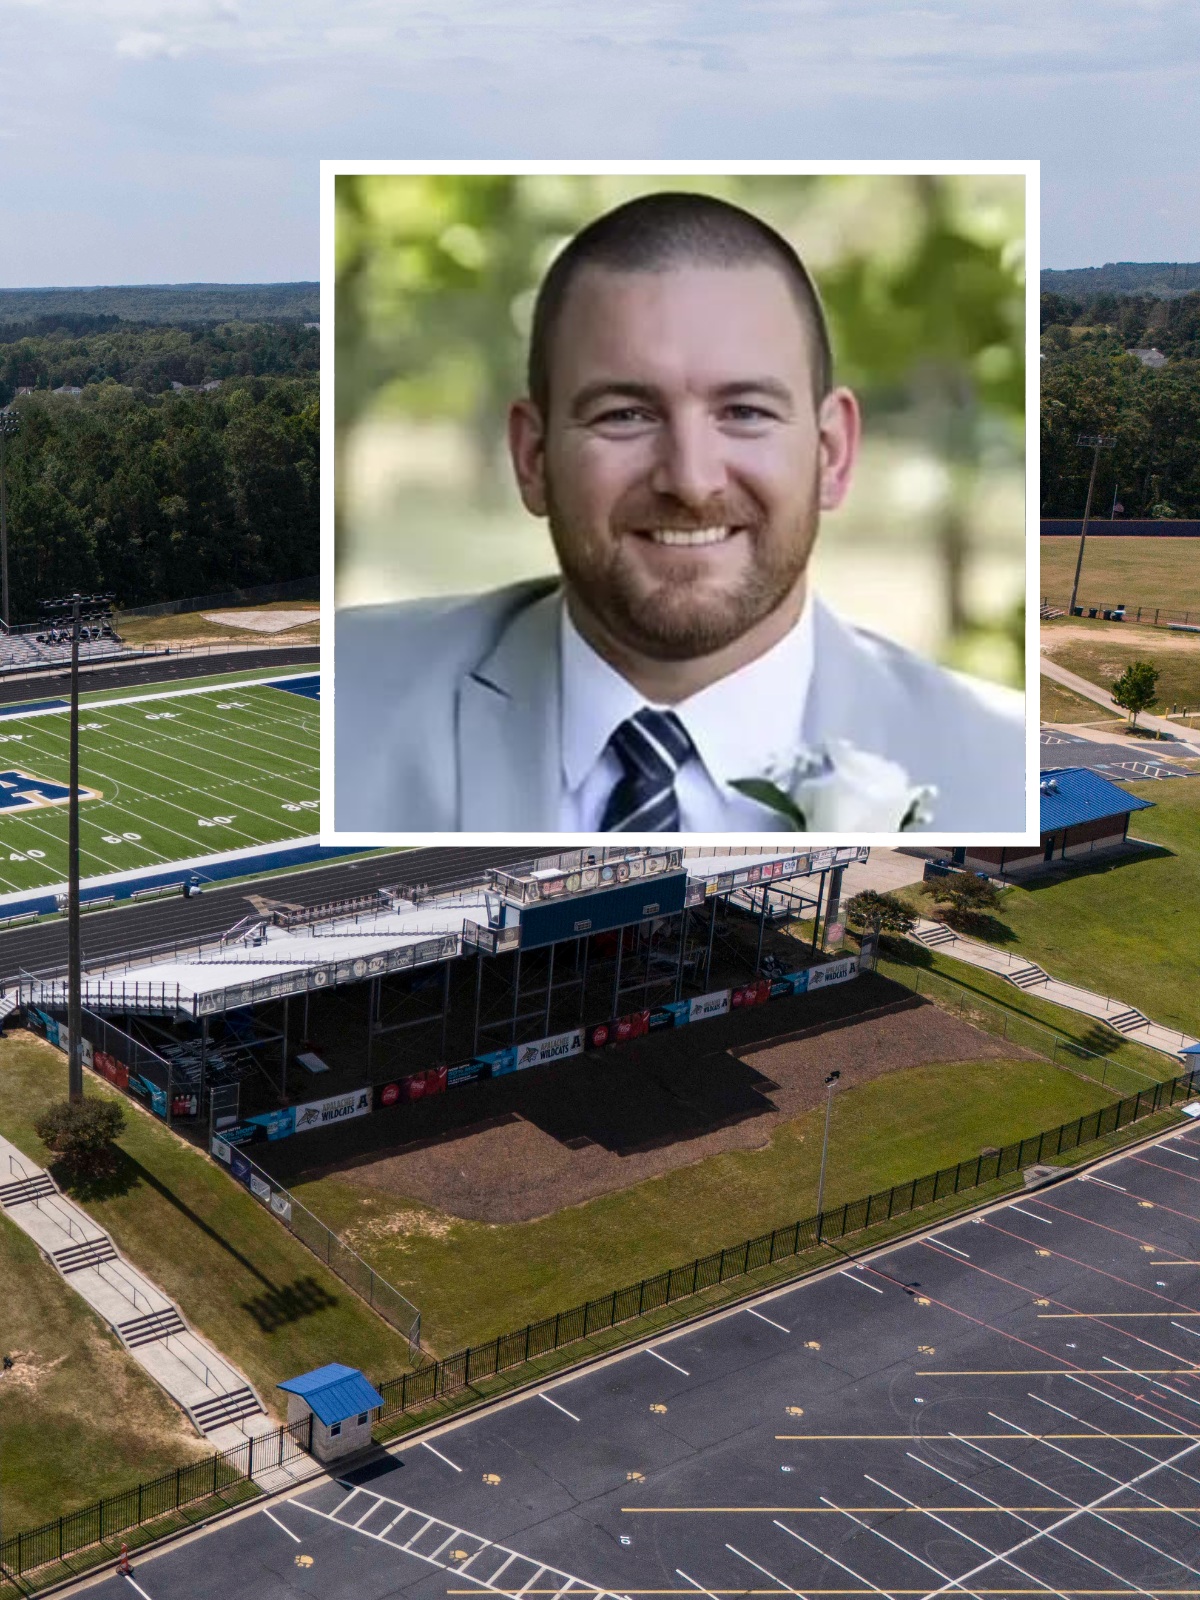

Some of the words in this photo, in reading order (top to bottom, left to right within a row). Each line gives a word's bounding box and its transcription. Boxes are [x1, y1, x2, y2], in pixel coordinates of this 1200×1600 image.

[281, 800, 319, 812] 30
[198, 816, 232, 827] 40
[101, 832, 142, 844] 50
[9, 849, 46, 862] 40
[442, 936, 456, 956] A
[849, 962, 856, 974] A
[199, 993, 216, 1012] A
[540, 1036, 569, 1050] APALACHEE
[570, 1035, 581, 1051] A
[540, 1044, 569, 1059] WILDCATS
[321, 1096, 355, 1112] APALACHEE
[356, 1094, 368, 1109] A
[321, 1105, 355, 1121] WILDCATS
[620, 1535, 631, 1545] 10
